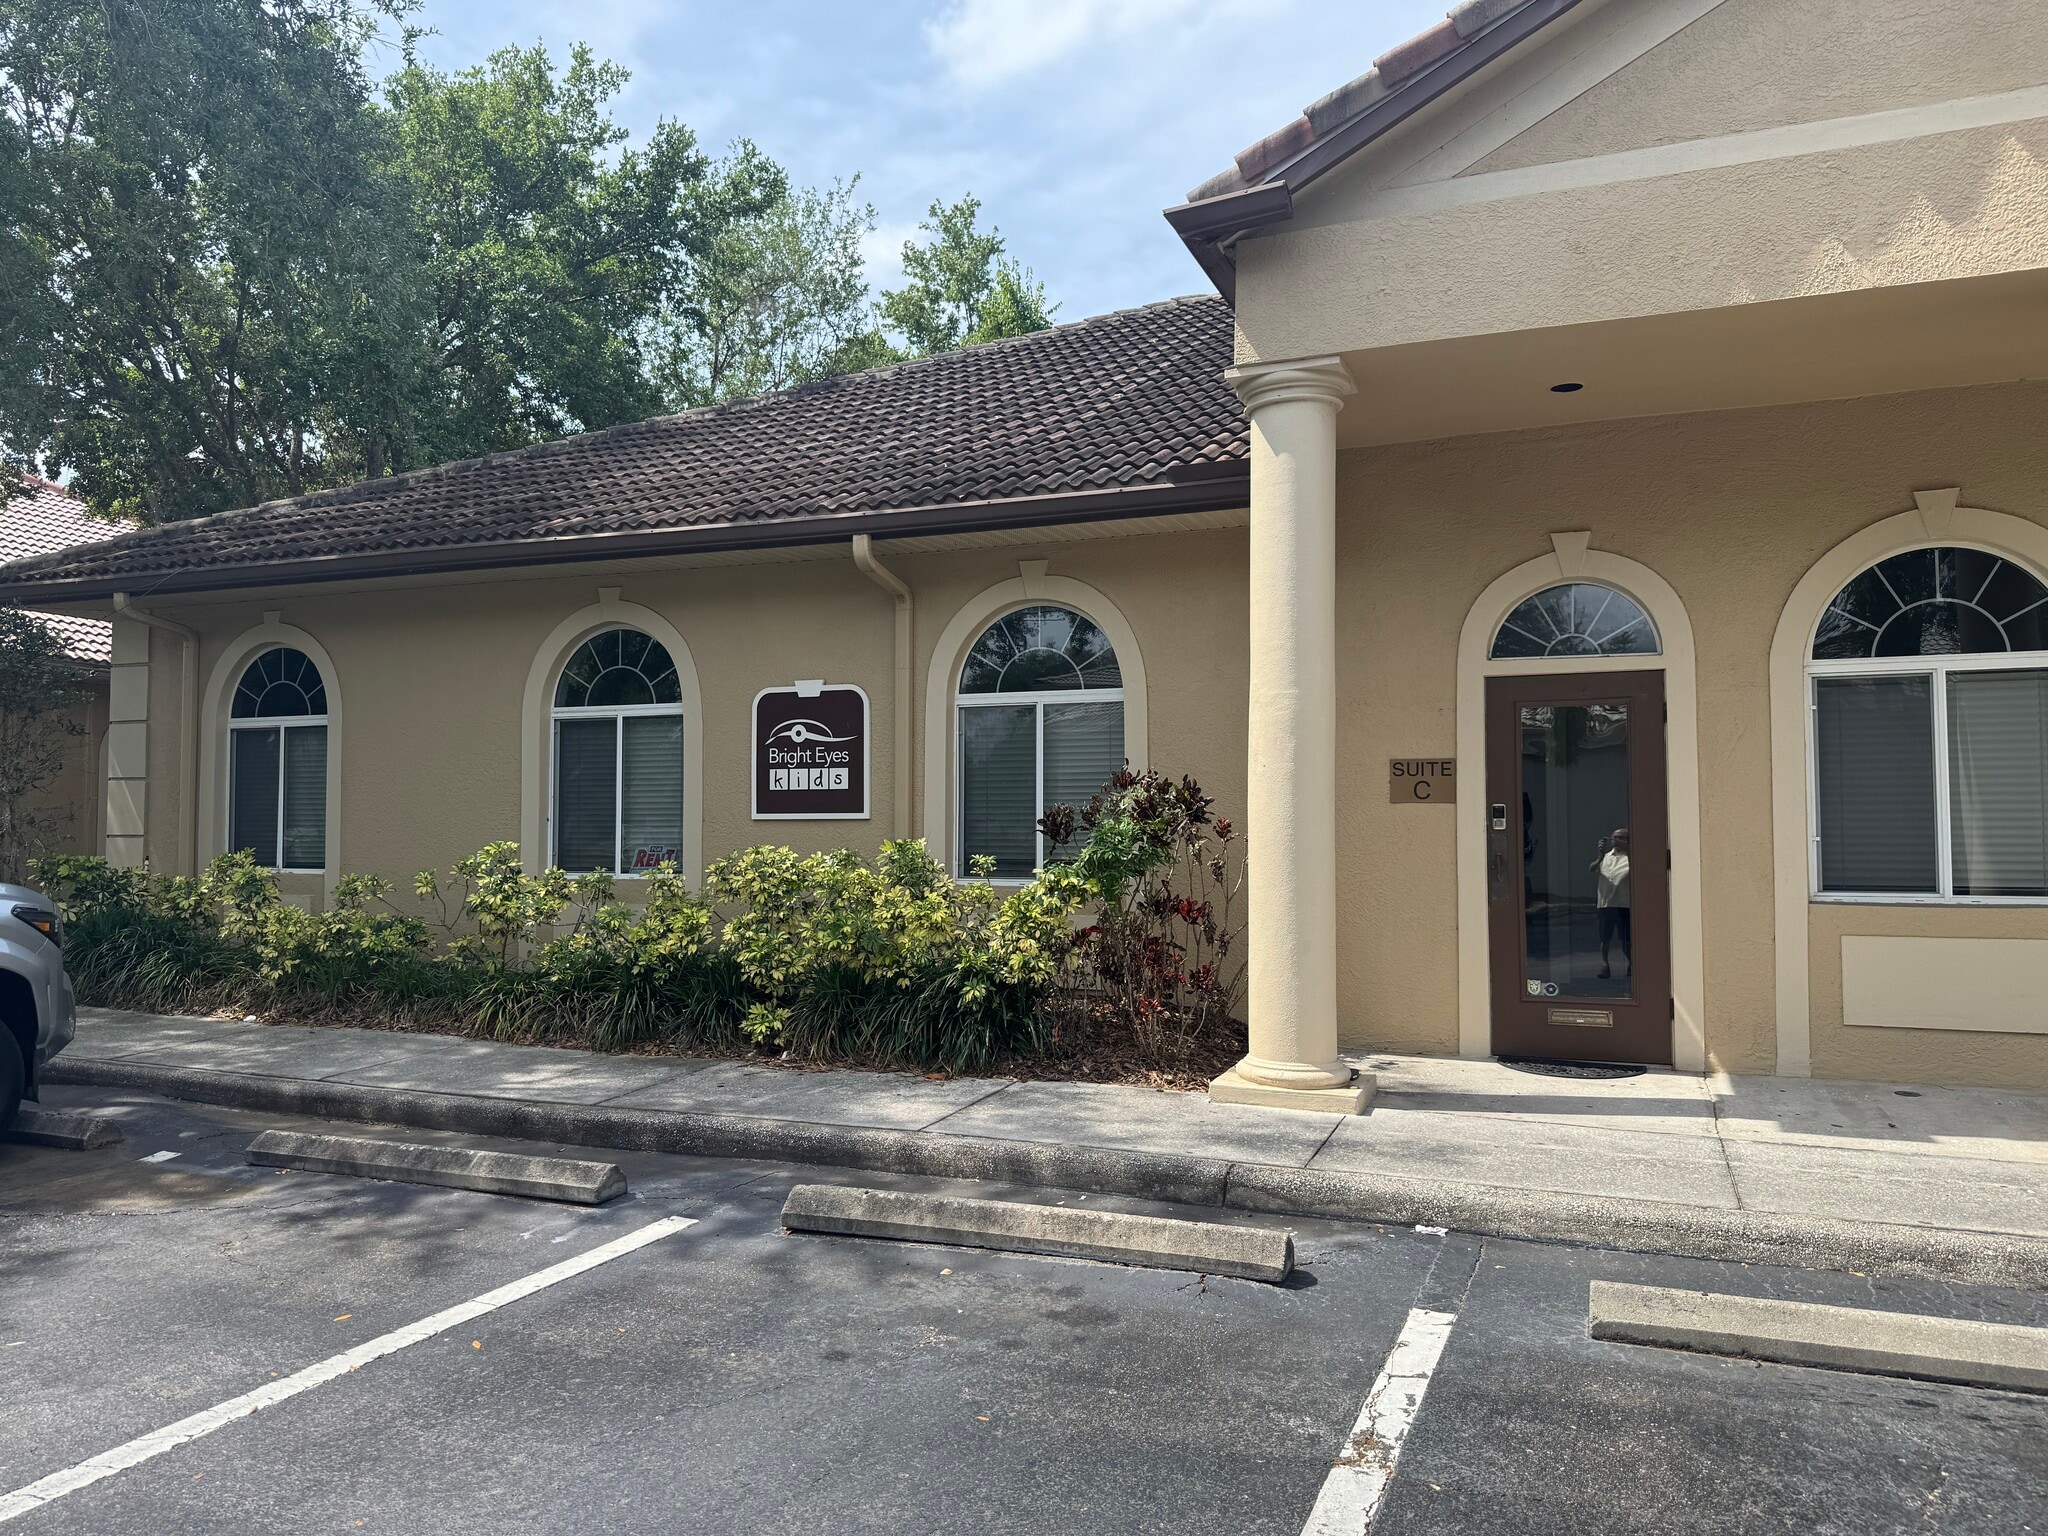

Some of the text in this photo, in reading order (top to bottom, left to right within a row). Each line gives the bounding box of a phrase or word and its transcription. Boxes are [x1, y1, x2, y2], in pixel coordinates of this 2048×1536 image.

[769, 746, 850, 768] Bright Eyes
[773, 769, 844, 789] kids
[1392, 761, 1452, 777] SUITE
[1413, 780, 1431, 800] C
[633, 849, 676, 868] RENT
